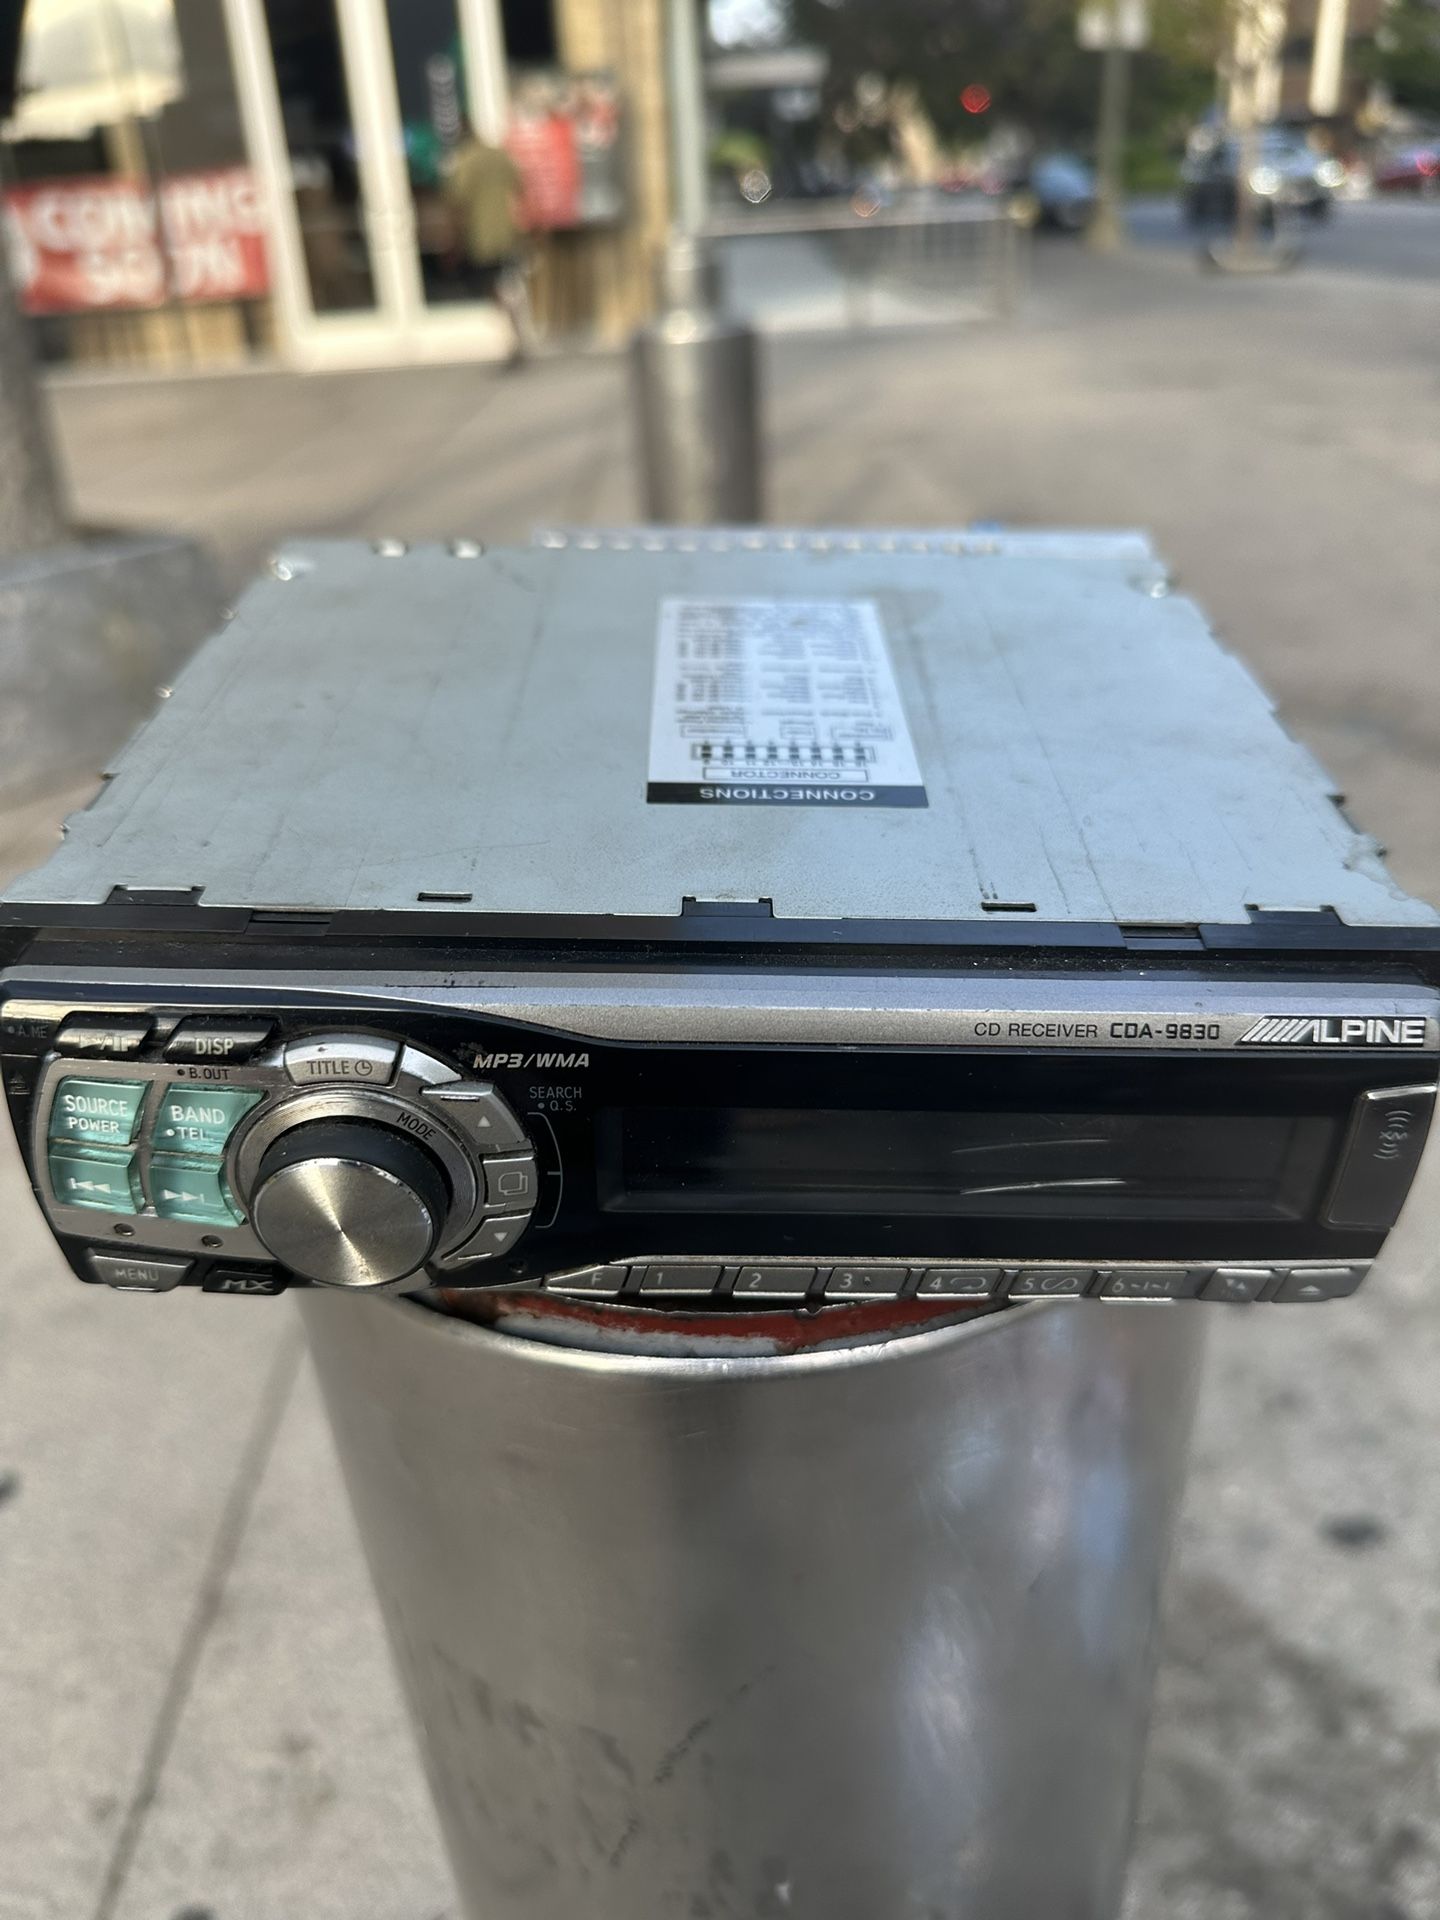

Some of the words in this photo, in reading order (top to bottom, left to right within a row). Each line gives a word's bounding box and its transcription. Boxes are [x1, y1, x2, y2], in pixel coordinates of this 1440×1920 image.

[730, 770, 840, 780] CONNECTOR
[699, 788, 875, 801] CONNECTIONS
[974, 1022, 1001, 1036] CD
[1008, 1023, 1098, 1038] RECEIVER
[1110, 1023, 1220, 1039] CDA-9830
[1290, 1019, 1425, 1044] ALPINE
[195, 1038, 234, 1056] DISP
[306, 1061, 349, 1075] TITLE
[473, 1053, 590, 1068] MP3/WMA
[529, 1086, 582, 1099] SEARCH
[64, 1094, 128, 1118] SOURCE
[171, 1105, 226, 1125] BAND
[68, 1117, 121, 1134] POWER
[397, 1111, 436, 1140] MODE
[114, 1268, 159, 1282] MENU
[591, 1273, 602, 1286] F
[656, 1272, 664, 1285] 1
[749, 1273, 762, 1288] 2
[840, 1273, 853, 1288] 3
[929, 1276, 942, 1290] 4
[1021, 1277, 1034, 1291] 5
[1112, 1278, 1125, 1293] 6
